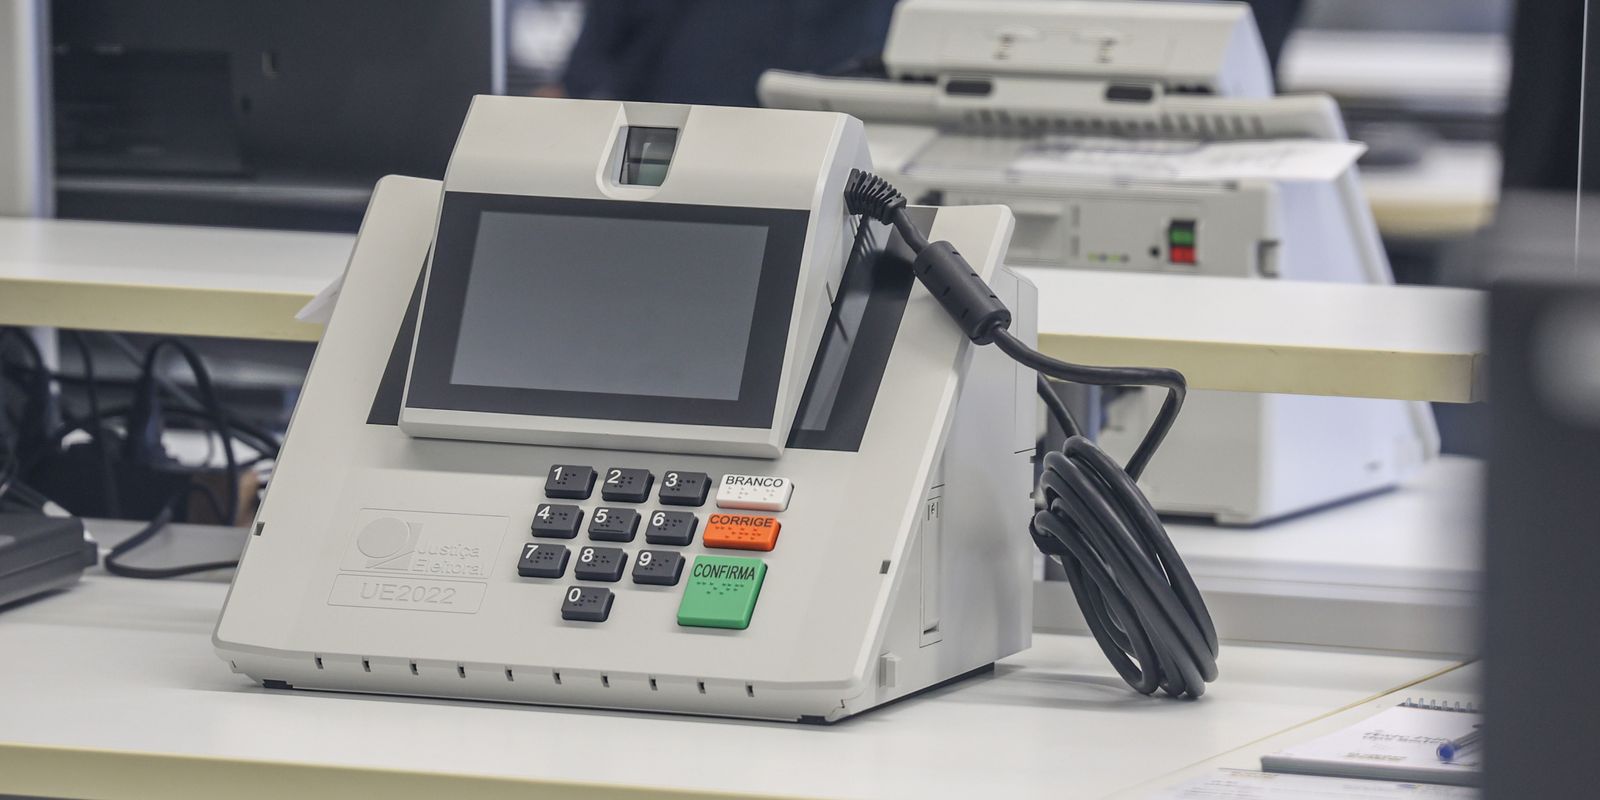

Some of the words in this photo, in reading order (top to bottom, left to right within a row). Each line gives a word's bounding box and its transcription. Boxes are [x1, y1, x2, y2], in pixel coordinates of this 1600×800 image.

[553, 467, 563, 481] 1
[608, 470, 622, 484] 2
[665, 473, 677, 487] 3
[725, 476, 784, 488] BRANCO
[537, 506, 550, 520] 4
[594, 509, 608, 523] 5
[652, 512, 664, 527] 6
[709, 515, 774, 528] CORRIGE
[413, 540, 481, 559] Justiça
[526, 545, 539, 559] 7
[581, 549, 593, 562] 8
[639, 552, 652, 566] 9
[412, 558, 485, 576] Eleitoral
[694, 563, 755, 581] CONFIRMA
[360, 582, 457, 605] UE2022
[568, 587, 581, 602] 0
